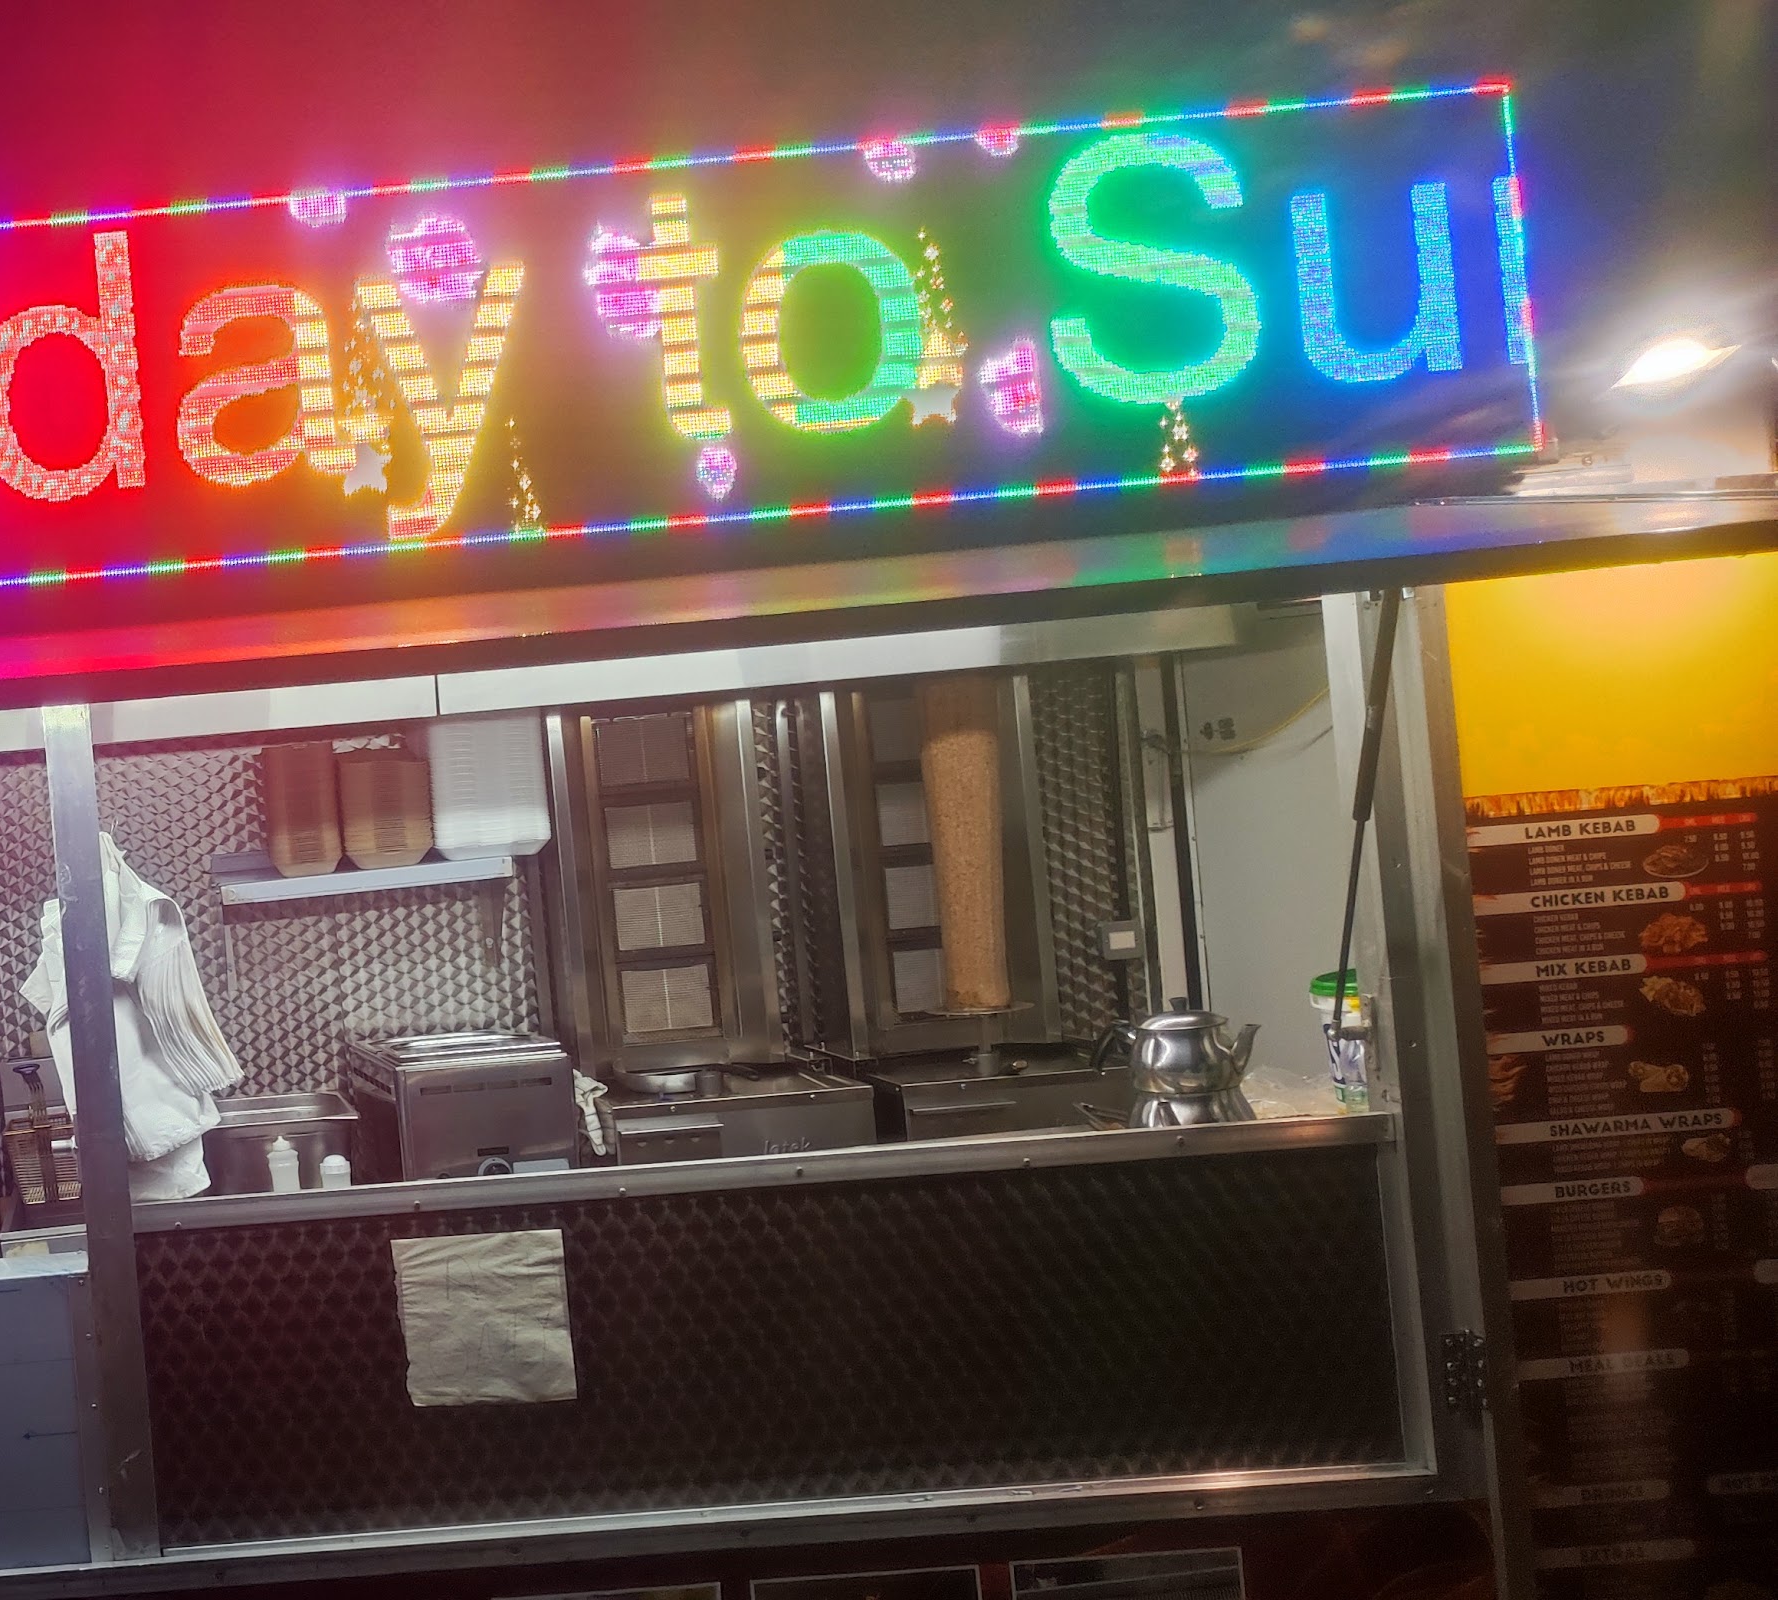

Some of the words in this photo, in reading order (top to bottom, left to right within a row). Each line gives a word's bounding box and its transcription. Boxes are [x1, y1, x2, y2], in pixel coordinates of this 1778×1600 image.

[634, 192, 922, 438] to
[1525, 824, 1571, 839] LAMB
[1579, 820, 1635, 835] KEBAB
[1531, 891, 1604, 908] CHICKEN
[1613, 886, 1669, 902] KEBAB
[1536, 963, 1567, 977] MIX
[1575, 959, 1631, 974] KEBAB
[1542, 1031, 1604, 1046] WRAPS
[1550, 1118, 1651, 1137] SHAWARMA
[1658, 1113, 1722, 1129] WRAPS
[1555, 1181, 1631, 1199] BURGERS
